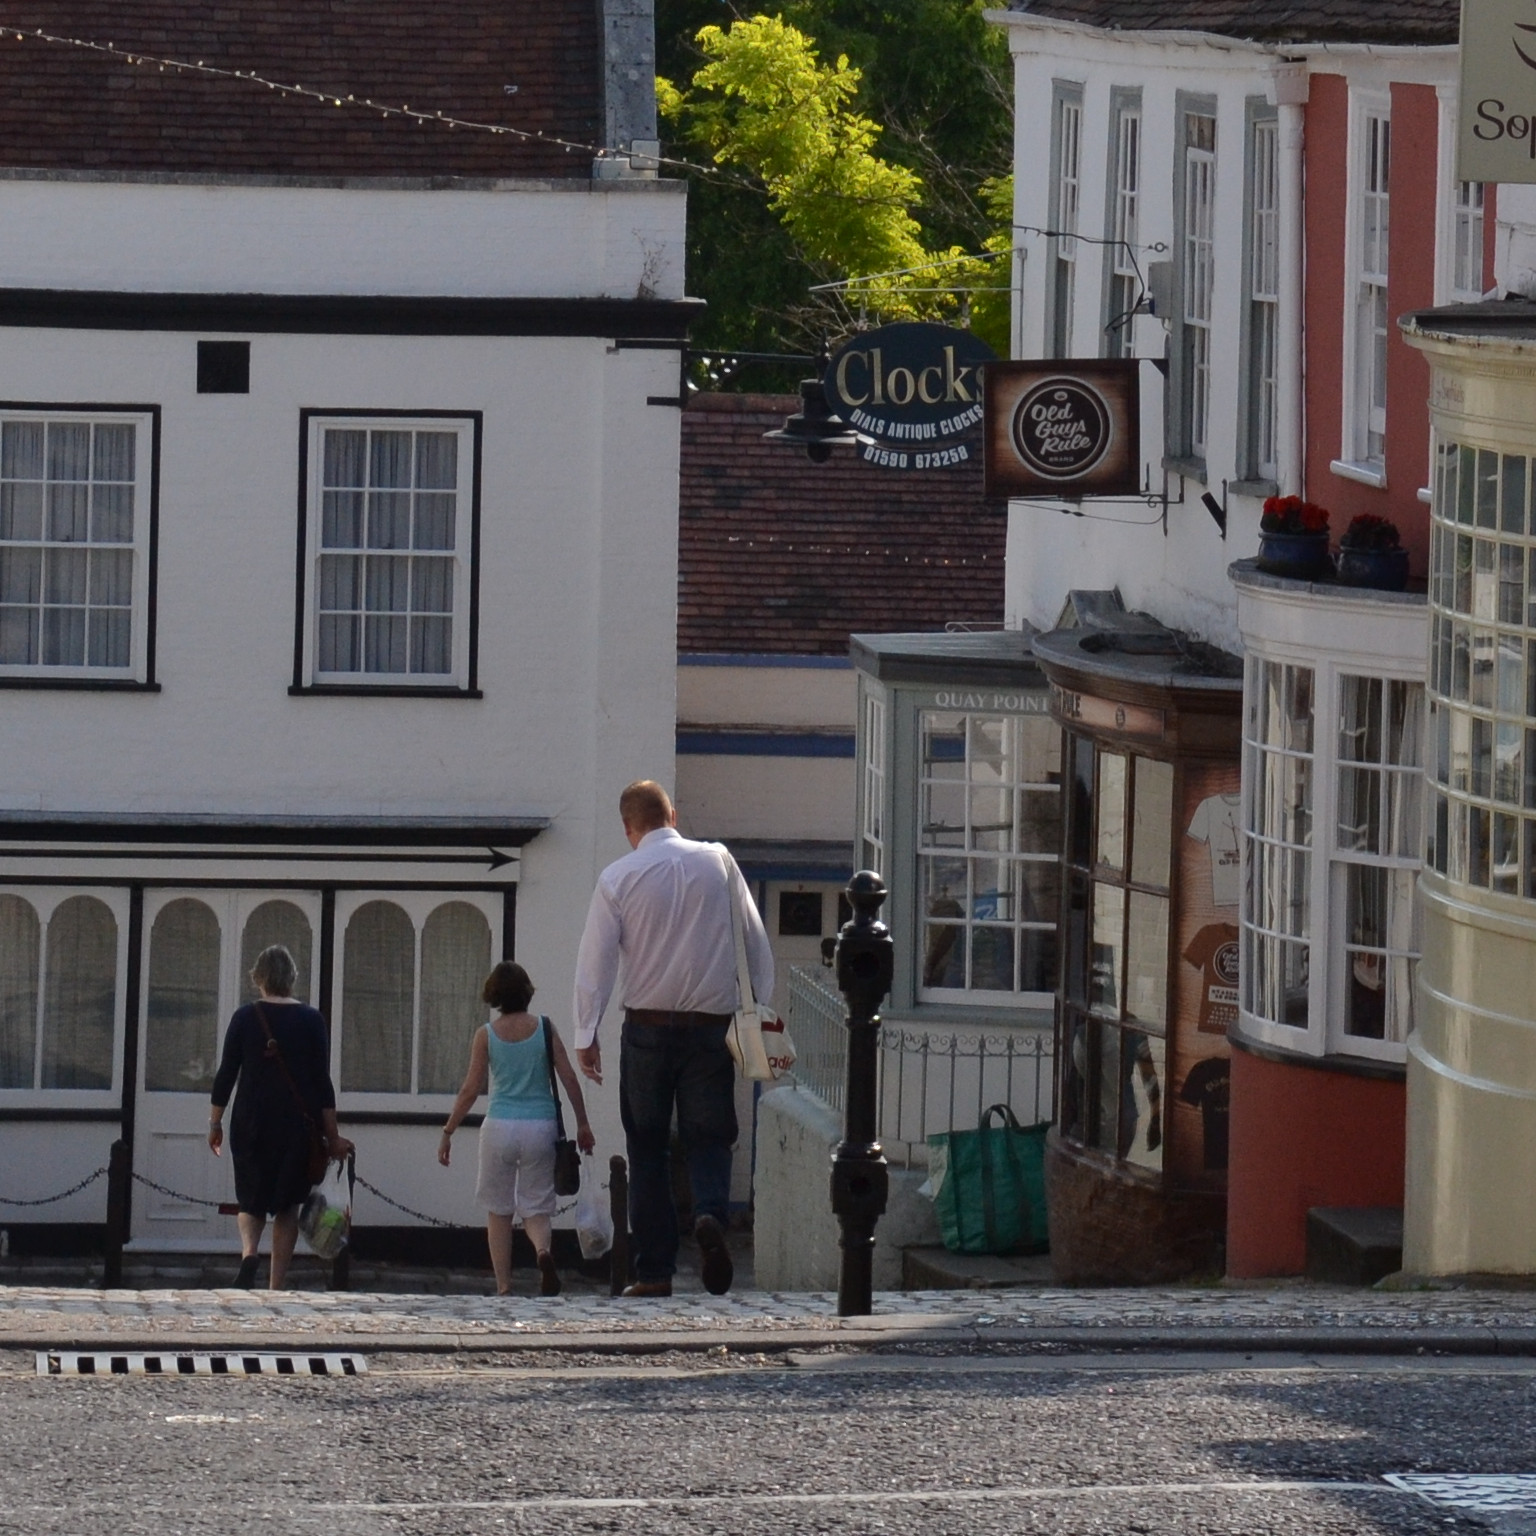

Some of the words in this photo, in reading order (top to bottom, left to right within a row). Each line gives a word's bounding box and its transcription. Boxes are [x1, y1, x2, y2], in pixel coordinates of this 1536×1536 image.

[1031, 402, 1074, 421] Old
[850, 408, 886, 435] DIALS
[887, 422, 937, 441] ANTIQUE
[939, 404, 984, 435] CLOCKS
[1035, 419, 1086, 439] Guys
[1040, 434, 1092, 455] Rule
[864, 446, 908, 468] 01590
[915, 445, 969, 468] 673258
[935, 691, 987, 709] QUAY
[993, 694, 1049, 711] POINT
